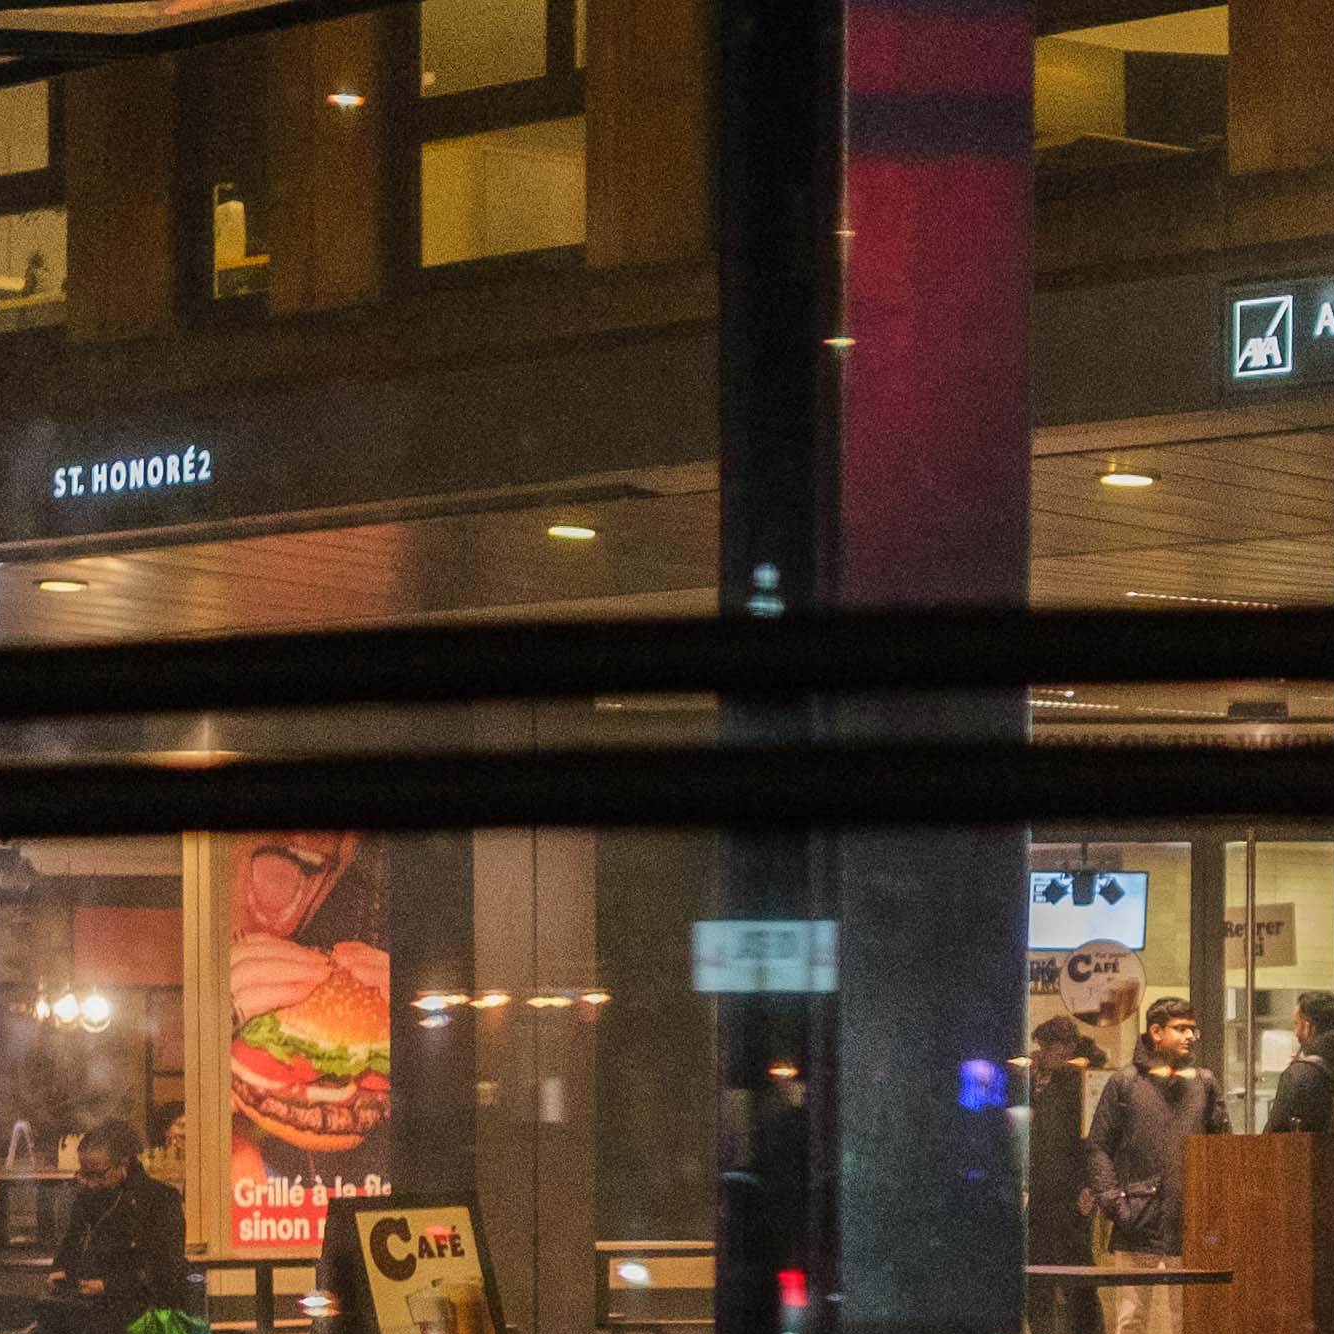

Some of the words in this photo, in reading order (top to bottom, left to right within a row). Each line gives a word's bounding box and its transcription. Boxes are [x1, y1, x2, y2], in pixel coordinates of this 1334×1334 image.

[53, 466, 85, 499] ST.
[1225, 920, 1285, 938] Rerer
[234, 1174, 305, 1208] Grillé
[312, 1174, 329, 1208] à
[335, 1174, 358, 1198] la
[239, 1210, 311, 1241] sinon
[370, 1217, 465, 1282] CAFÉ
